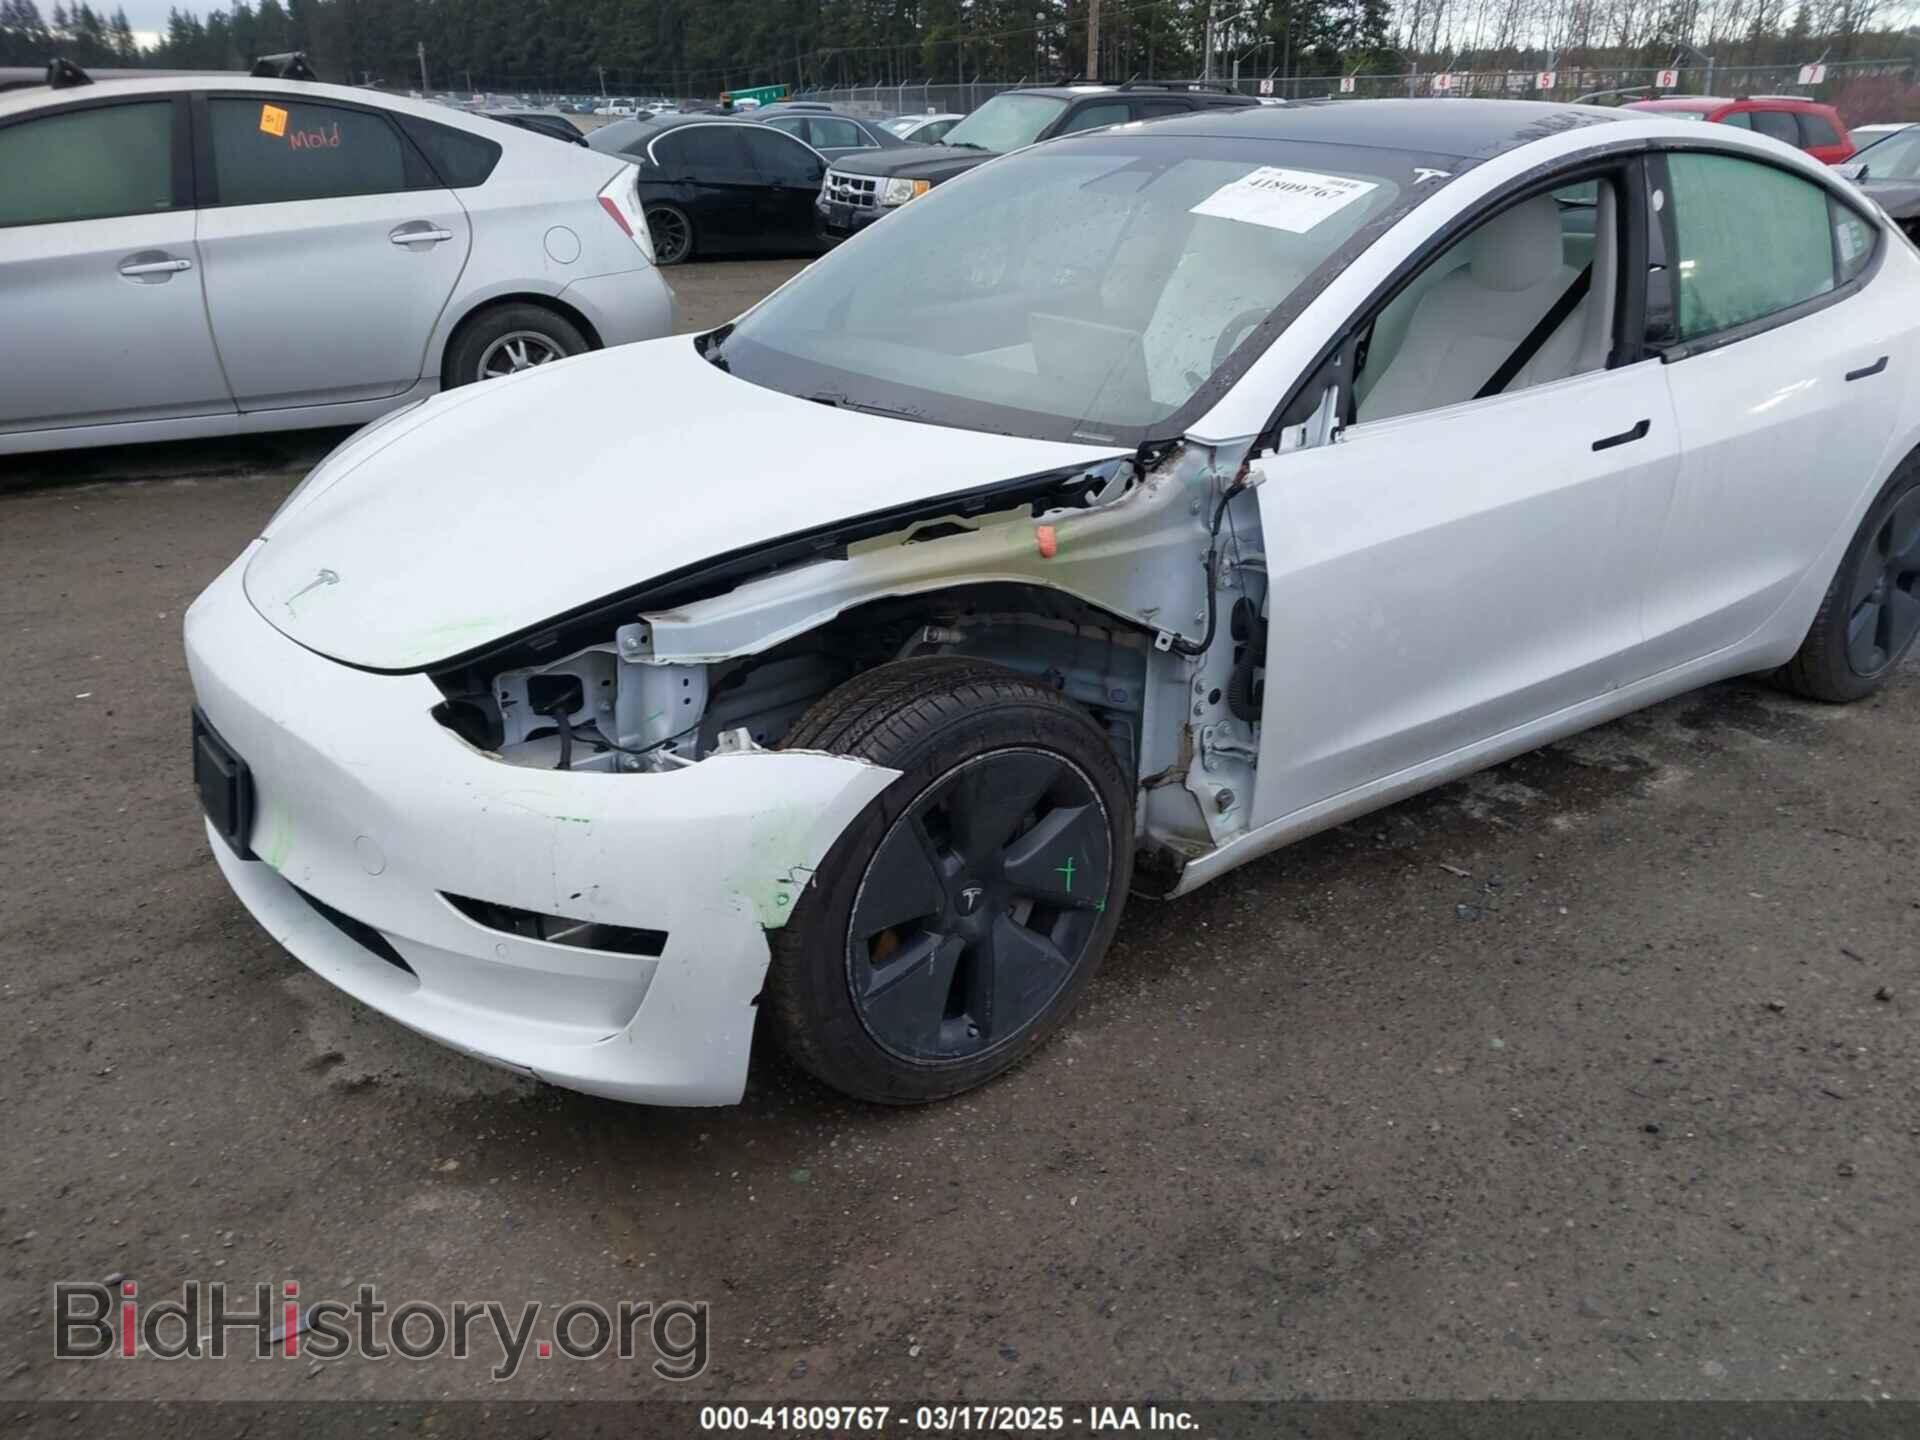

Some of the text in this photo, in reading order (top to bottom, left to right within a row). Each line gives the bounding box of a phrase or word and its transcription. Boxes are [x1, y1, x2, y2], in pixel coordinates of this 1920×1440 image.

[1541, 72, 1550, 87] 5
[1663, 72, 1671, 86] 6
[1807, 64, 1818, 83] 7
[289, 121, 340, 150] Mold
[1248, 178, 1346, 200] 41809767
